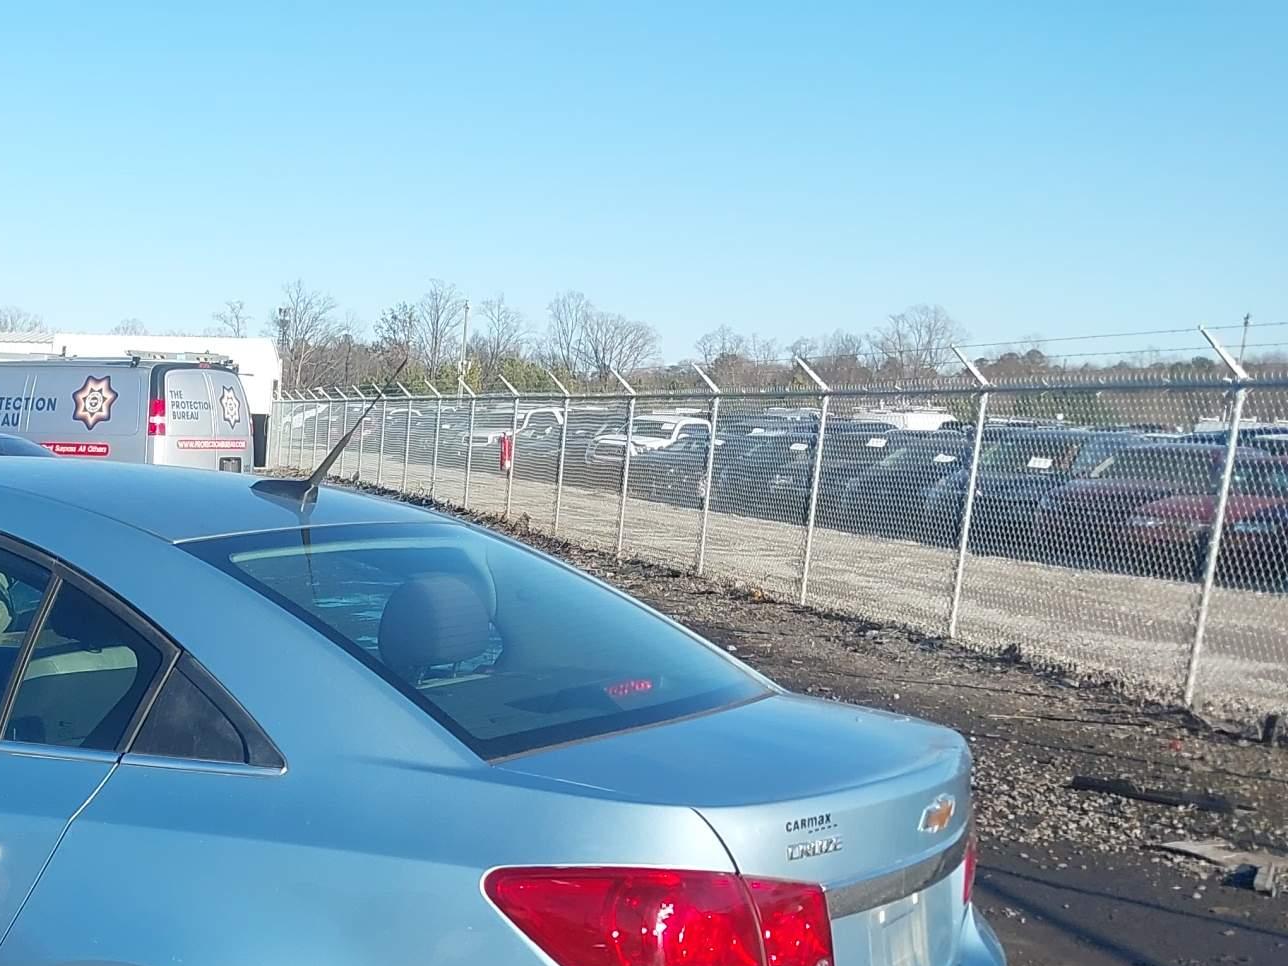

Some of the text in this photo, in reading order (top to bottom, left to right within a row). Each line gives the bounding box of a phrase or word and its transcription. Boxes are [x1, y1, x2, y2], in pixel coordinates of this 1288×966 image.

[169, 390, 183, 399] THE
[172, 411, 199, 420] BUREAU
[78, 444, 86, 453] All
[787, 836, 843, 861] CRUZE
